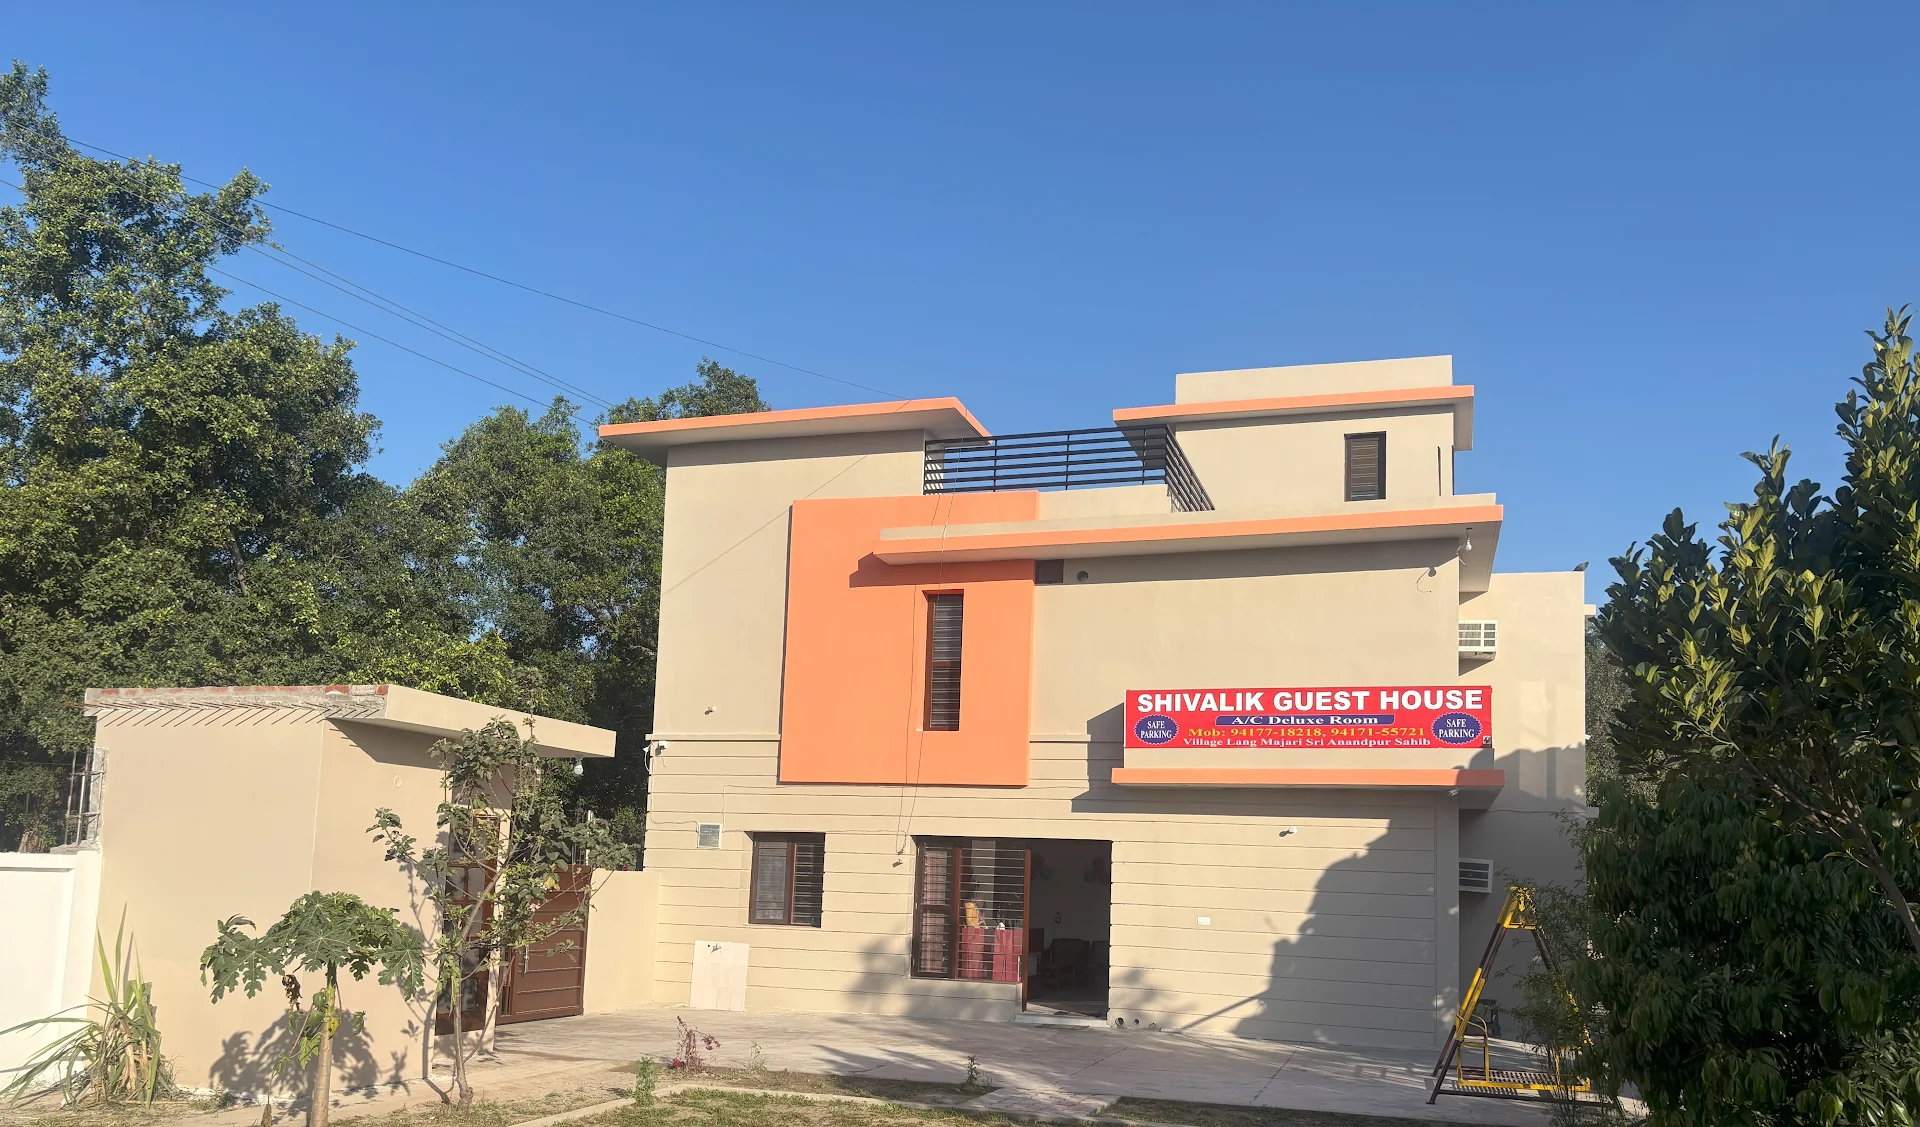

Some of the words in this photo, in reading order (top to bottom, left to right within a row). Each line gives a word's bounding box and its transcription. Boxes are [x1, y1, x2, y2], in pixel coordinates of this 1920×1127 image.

[1137, 692, 1265, 712] SHIVALIK
[1273, 690, 1370, 711] GUEST
[1380, 689, 1483, 710] HOUSE
[1147, 720, 1165, 729] SAFE
[1231, 715, 1264, 725] A/C
[1268, 715, 1324, 725] Deluxe
[1329, 715, 1379, 724] Room
[1446, 718, 1467, 728] SAFE
[1140, 730, 1172, 739] PARKING
[1188, 728, 1226, 737] Mob:
[1230, 727, 1327, 738] 94177-18218,
[1330, 727, 1425, 736] 94171-55721
[1438, 728, 1475, 738] PARKING
[1183, 738, 1223, 747] Village
[1226, 738, 1257, 747] Lang
[1260, 738, 1303, 748] Majari
[1305, 738, 1324, 746] Sri
[1327, 738, 1392, 748] Anandpur
[1394, 737, 1431, 746] Sahib
